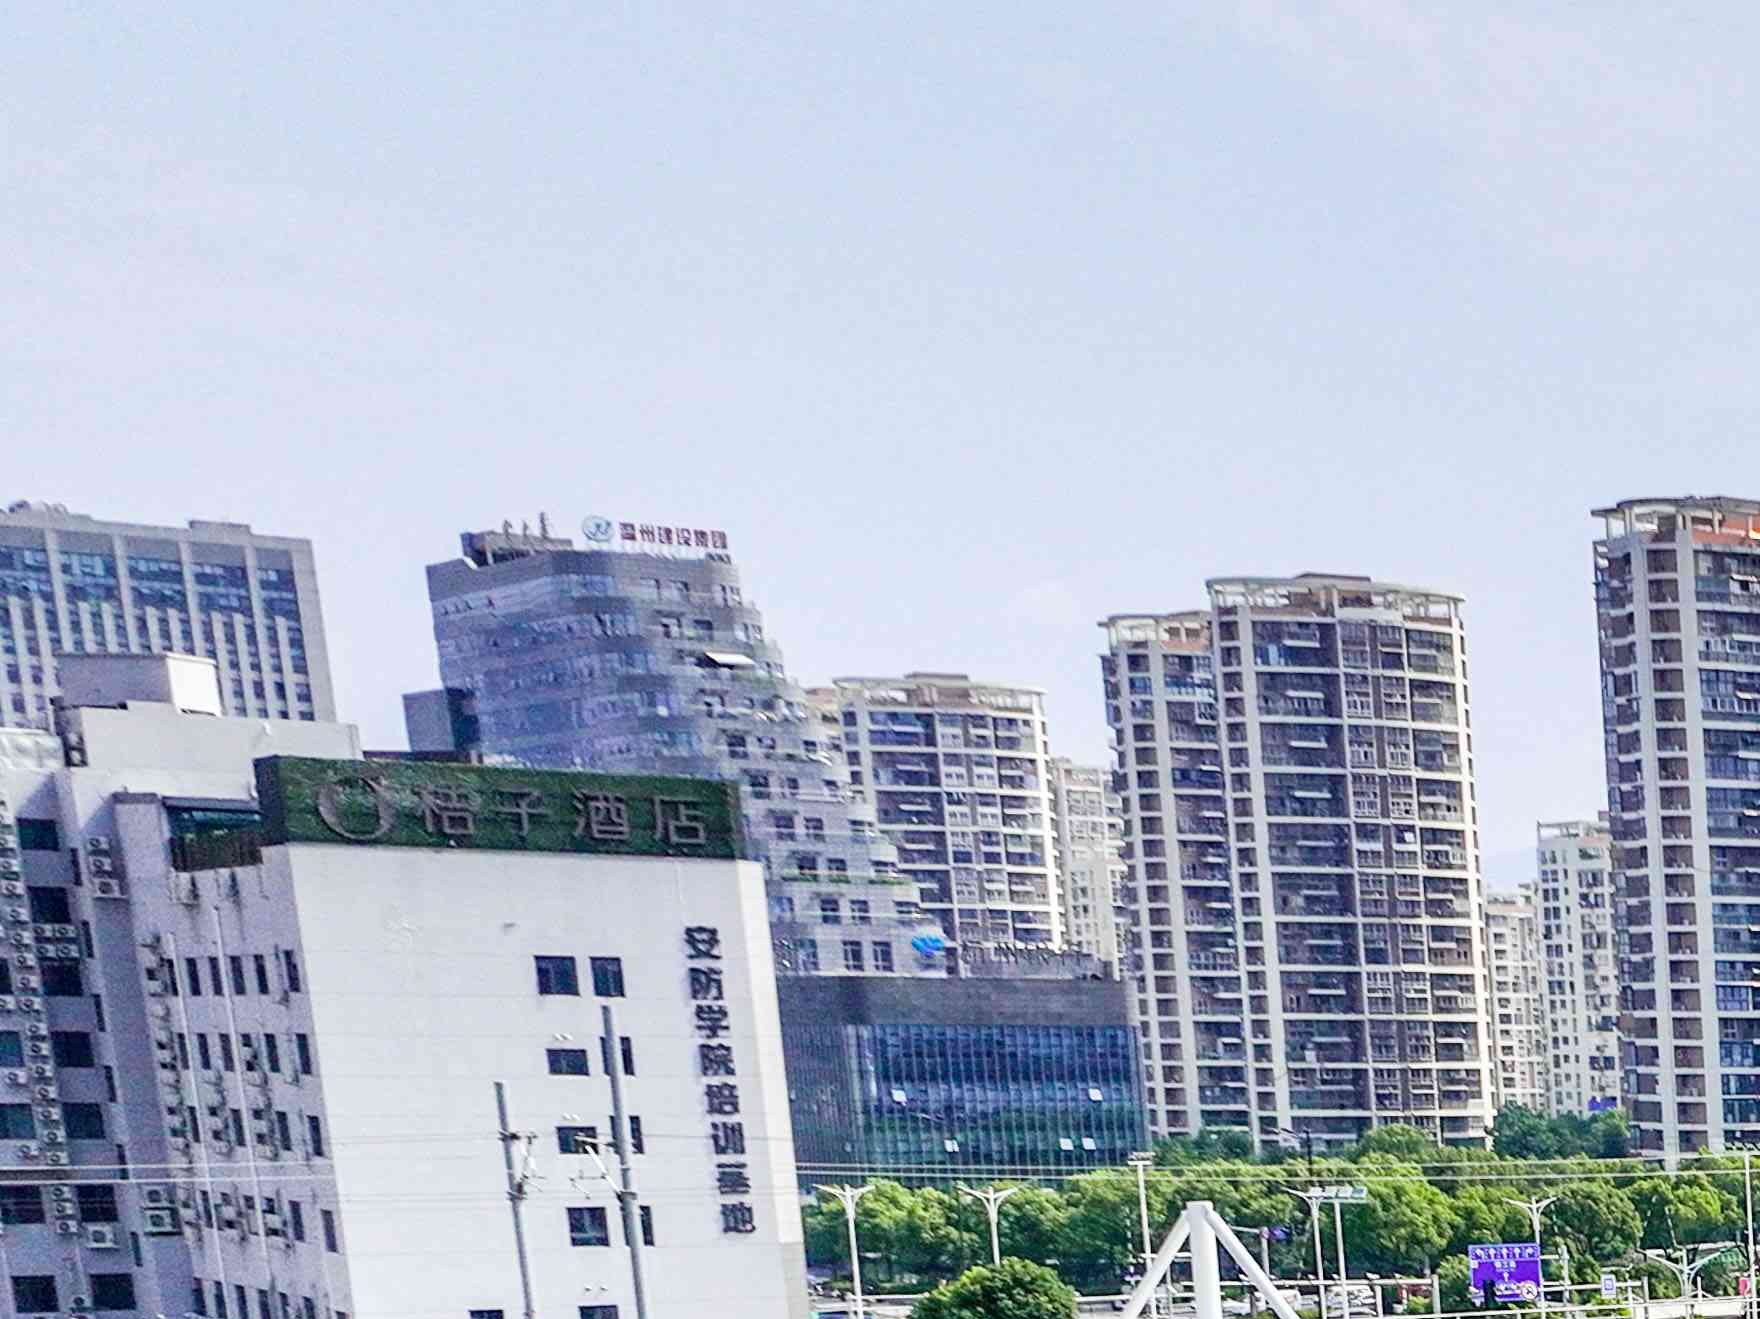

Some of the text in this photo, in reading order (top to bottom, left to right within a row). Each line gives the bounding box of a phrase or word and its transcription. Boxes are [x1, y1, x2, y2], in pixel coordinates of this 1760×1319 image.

[683, 926, 756, 1233] 安防学院培训基地
